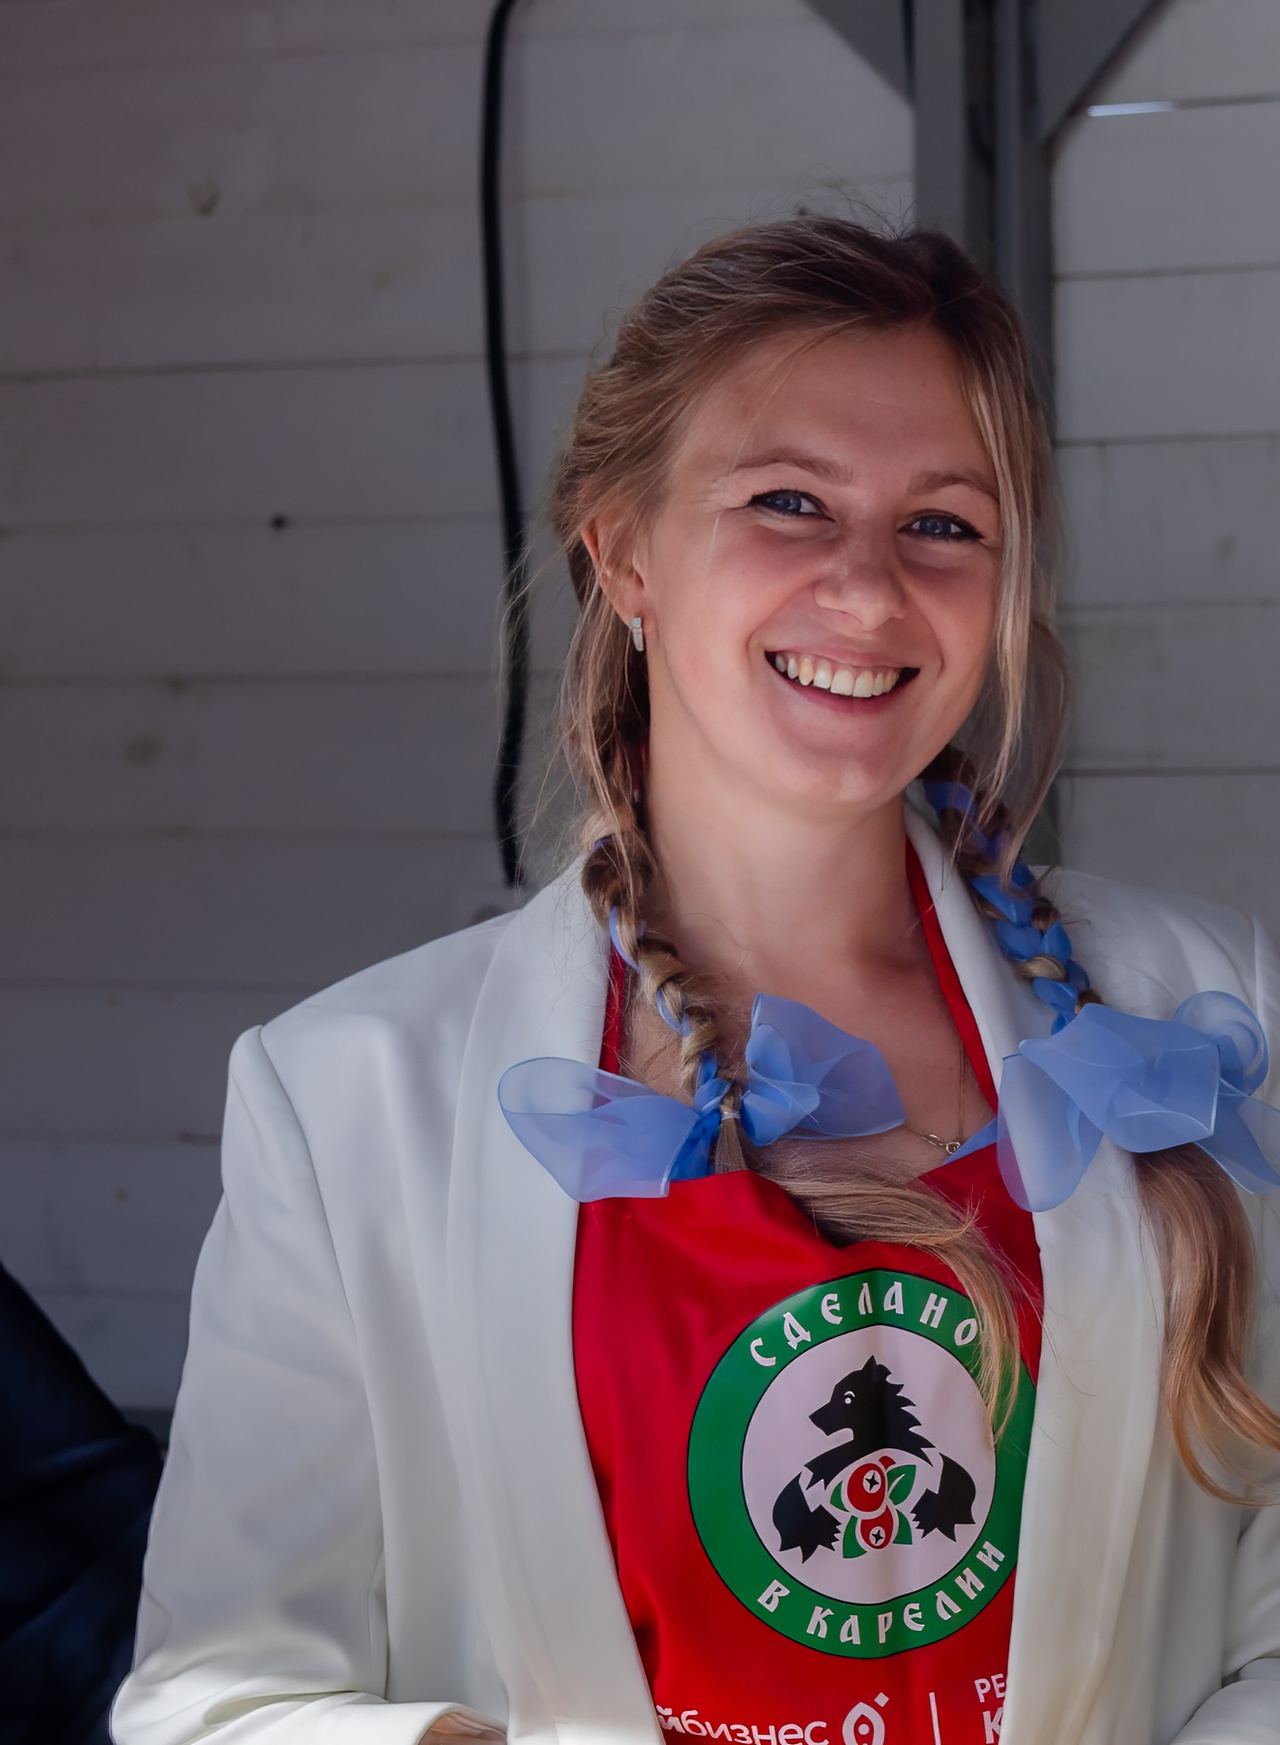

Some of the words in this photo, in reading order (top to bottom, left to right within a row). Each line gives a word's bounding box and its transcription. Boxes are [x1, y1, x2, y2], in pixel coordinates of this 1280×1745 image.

[750, 1281, 978, 1367] СДЕЛАНО
[757, 1579, 790, 1612] В
[806, 1541, 1006, 1645] КАРЕЛИИ
